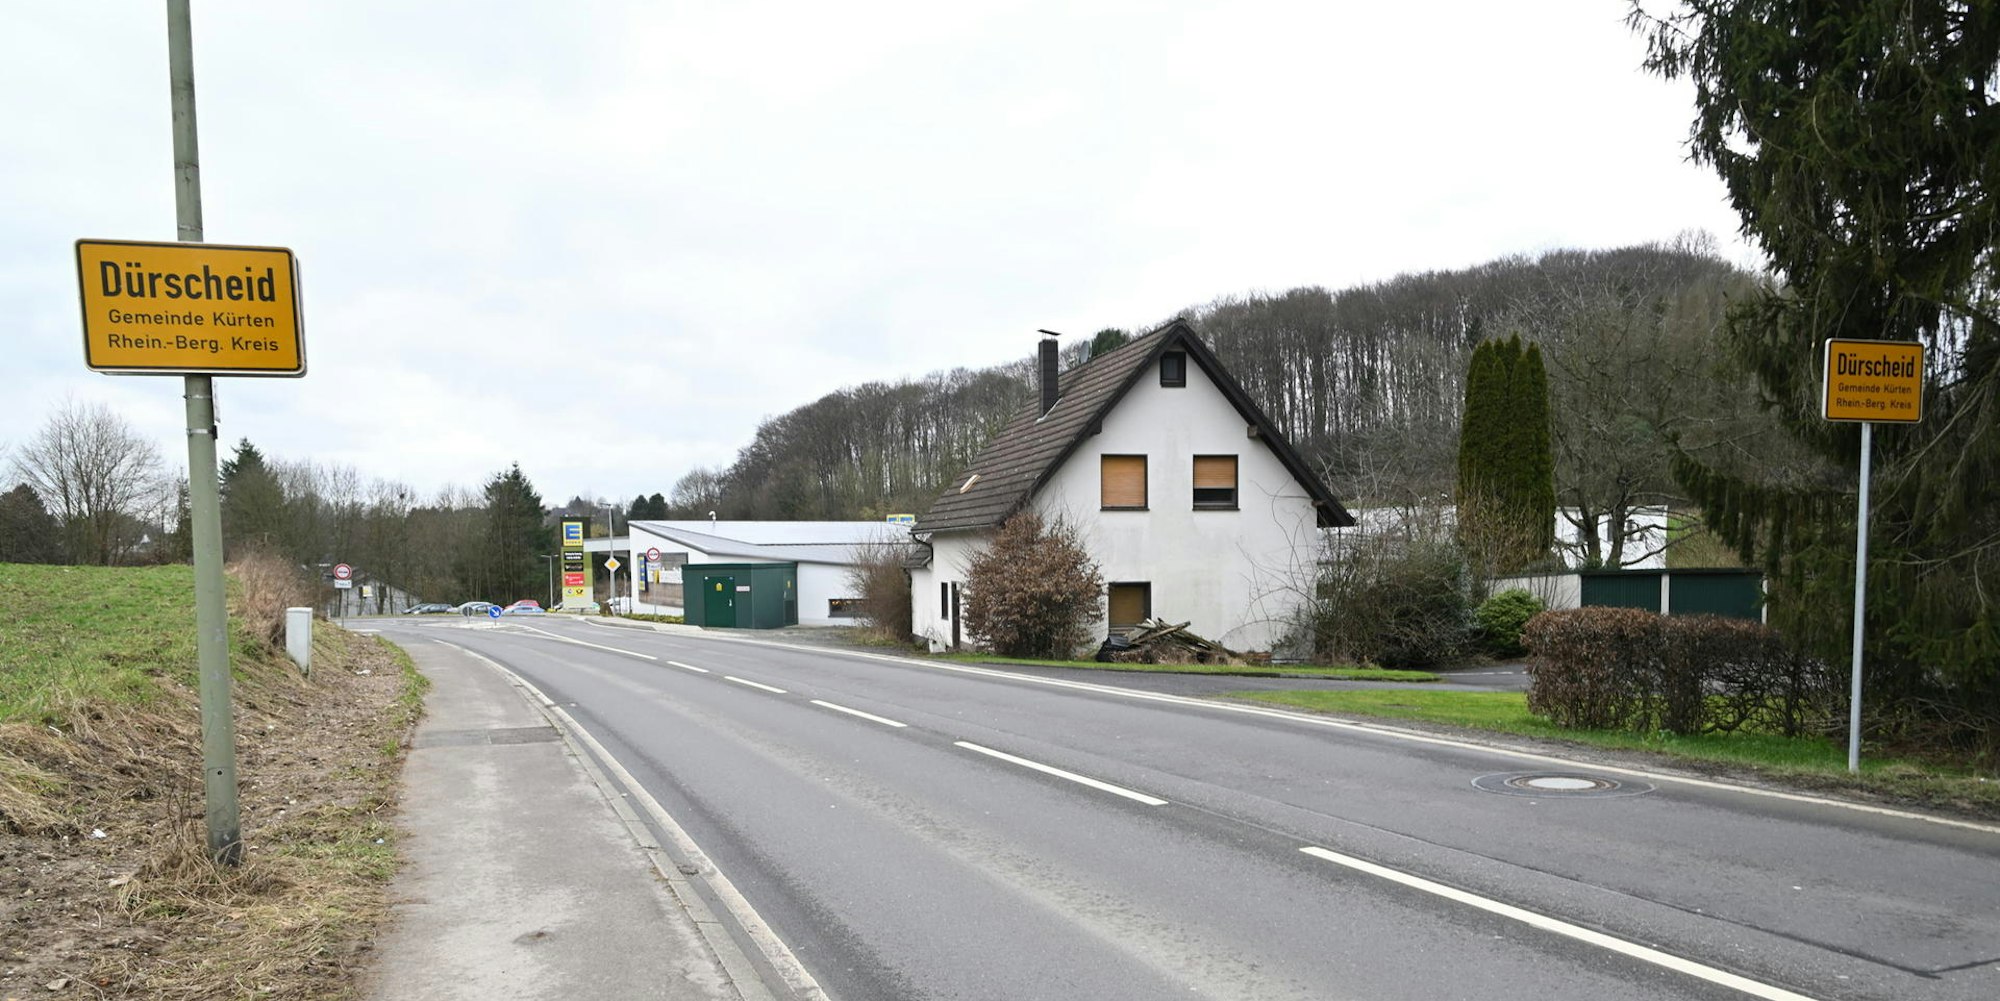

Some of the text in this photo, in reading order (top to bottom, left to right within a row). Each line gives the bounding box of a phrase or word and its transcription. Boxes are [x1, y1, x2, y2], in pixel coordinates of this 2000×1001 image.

[100, 260, 275, 302] Dürscheid
[108, 308, 275, 328] Gemeinde Kürten
[108, 333, 279, 353] Rhein.-Berg. Kreis
[1837, 352, 1915, 378] Dürscheid
[1838, 382, 1912, 394] Gemeinde Kürten
[1889, 398, 1912, 409] Kreis
[565, 524, 580, 540] E
